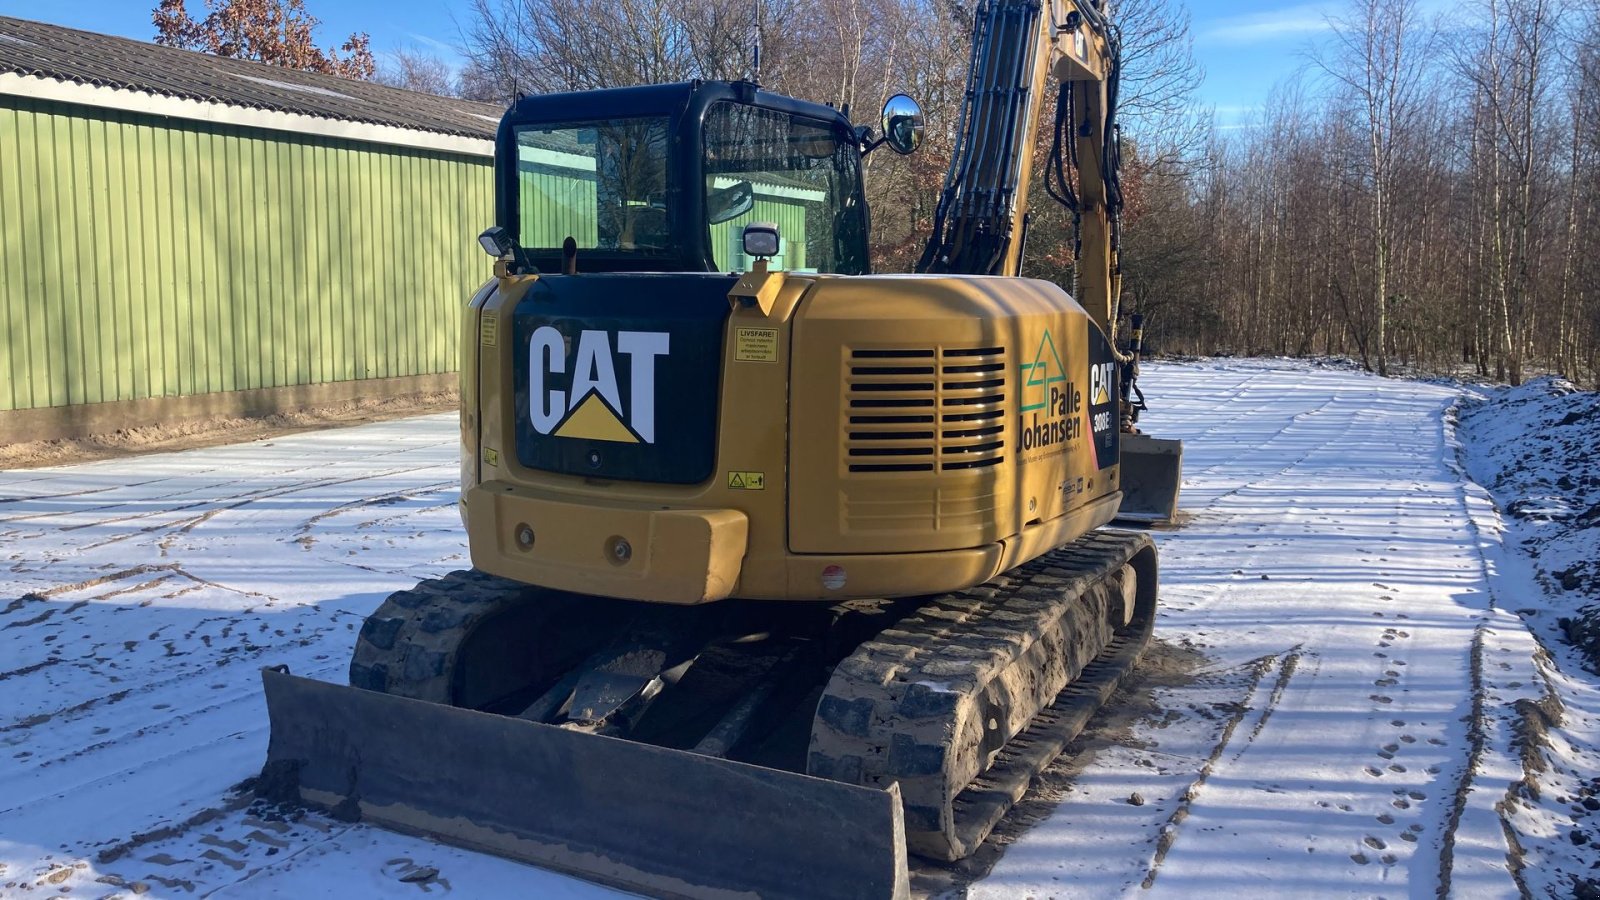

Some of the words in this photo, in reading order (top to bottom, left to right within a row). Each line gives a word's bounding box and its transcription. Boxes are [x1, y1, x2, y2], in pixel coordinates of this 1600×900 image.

[529, 325, 670, 444] CAT
[1050, 381, 1081, 417] Palle
[1090, 362, 1114, 406] CAT
[1015, 412, 1080, 454] Johansen
